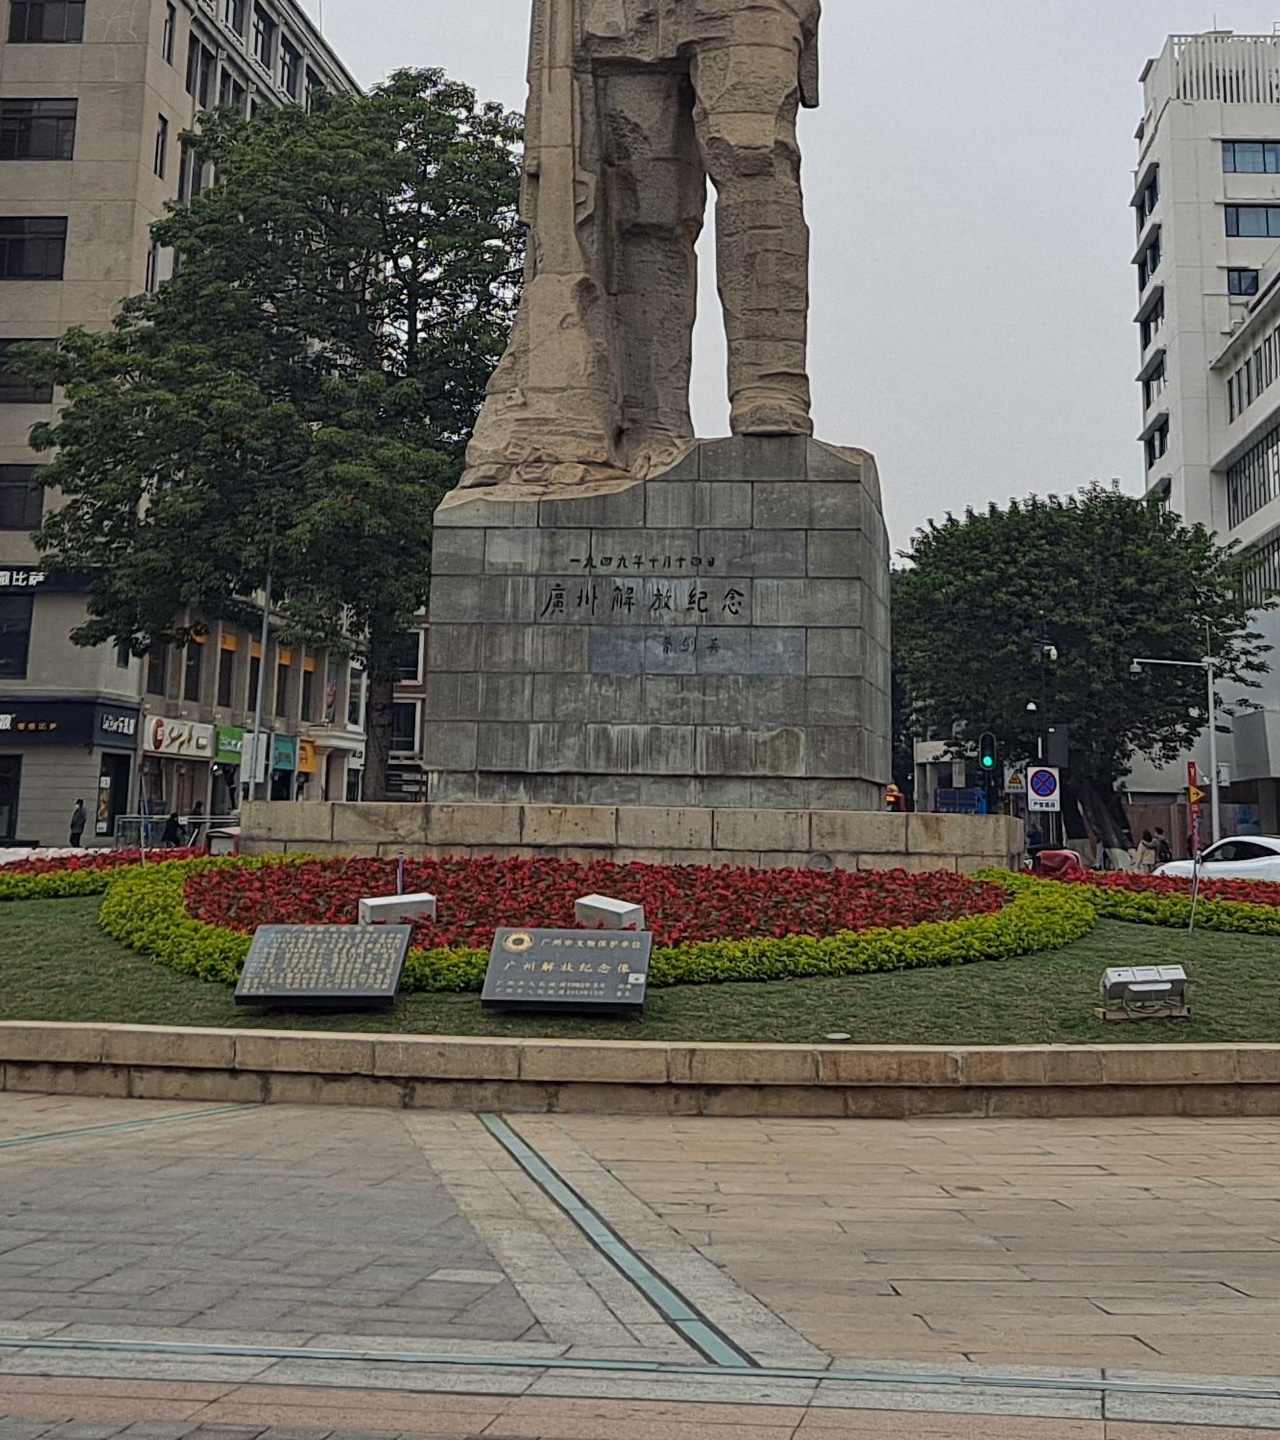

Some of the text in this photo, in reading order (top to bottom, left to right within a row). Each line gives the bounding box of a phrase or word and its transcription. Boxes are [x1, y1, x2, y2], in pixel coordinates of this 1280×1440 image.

[569, 554, 716, 570] 一九四九年十月十四日
